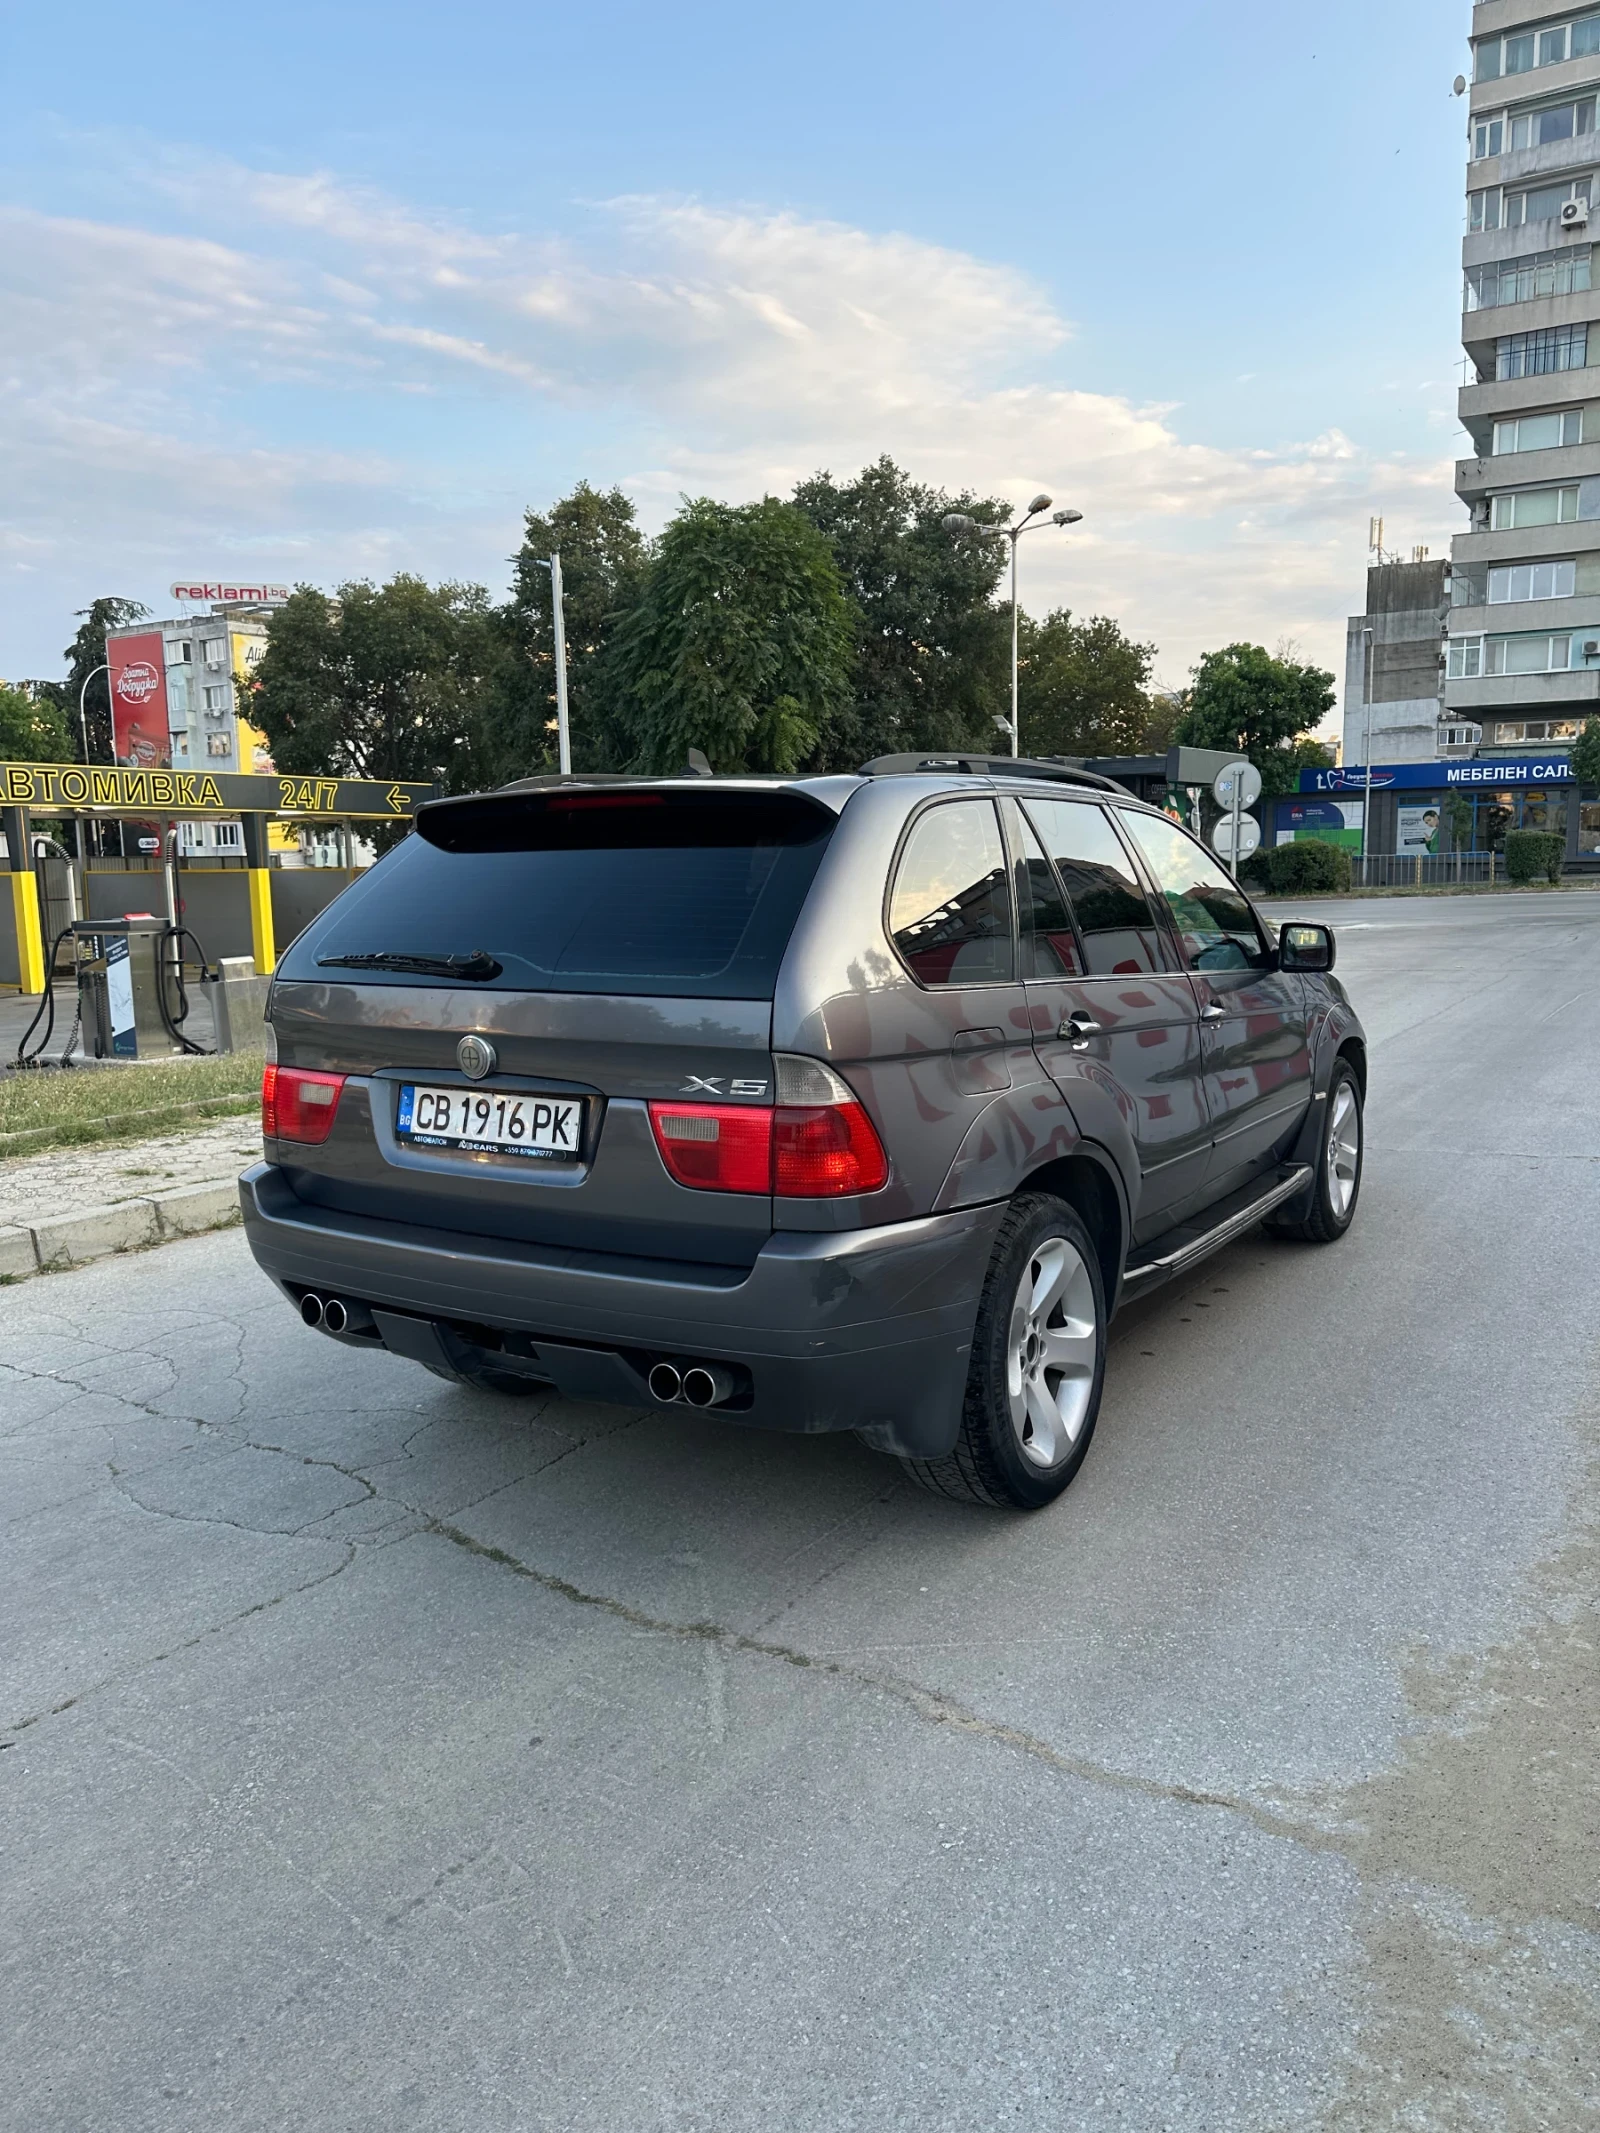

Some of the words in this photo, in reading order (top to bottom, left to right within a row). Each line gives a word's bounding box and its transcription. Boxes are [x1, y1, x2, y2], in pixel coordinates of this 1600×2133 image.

[175, 584, 287, 600] reklami.bg
[117, 677, 157, 697] Добруджа
[1447, 766, 1527, 781] МЕБЕЛЕН
[0, 767, 224, 806] ВТОМИВКА
[279, 779, 338, 810] 24/7
[679, 1075, 769, 1097] X5
[400, 1114, 411, 1125] BG
[416, 1093, 450, 1131] CB
[461, 1097, 525, 1139] 1916
[531, 1103, 573, 1145] PK
[505, 1146, 519, 1154] +359
